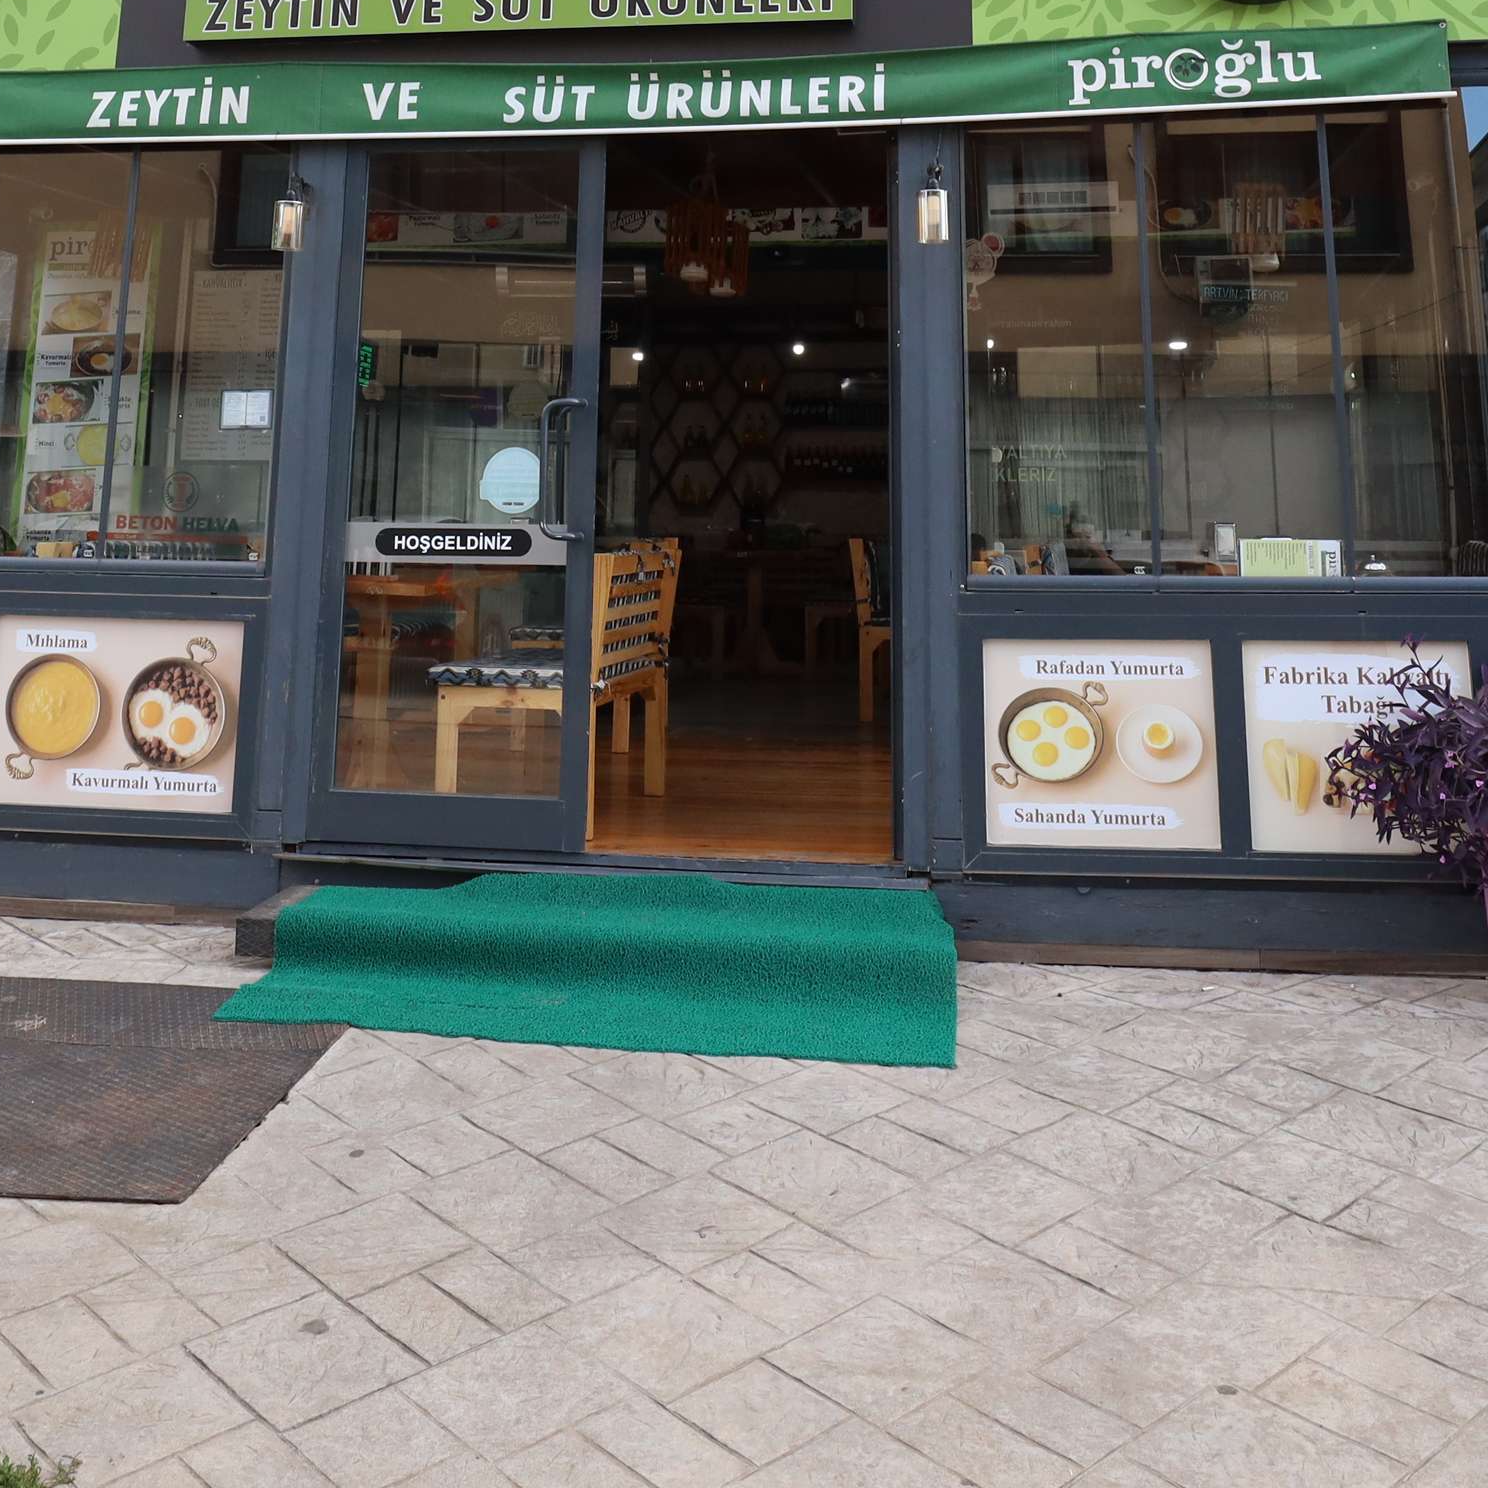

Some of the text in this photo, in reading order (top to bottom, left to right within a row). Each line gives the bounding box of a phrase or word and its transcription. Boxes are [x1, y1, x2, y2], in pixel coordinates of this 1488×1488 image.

[87, 76, 251, 129] ZEYTİN
[362, 82, 421, 122] VE
[502, 75, 596, 123] SÜT
[627, 63, 886, 119] ÜRÜNLERİ
[1068, 39, 1322, 105] piroğlu
[394, 532, 512, 553] HOŞGELDİNİZ
[26, 633, 88, 649] Mıhlama
[1036, 660, 1185, 676] Rafadan Yumurta
[1263, 666, 1347, 686] Fabrika
[1321, 695, 1394, 720] Tabağı
[72, 772, 217, 793] Kavurmalı Yumurta
[1014, 807, 1166, 826] Sahanda Yumurta
